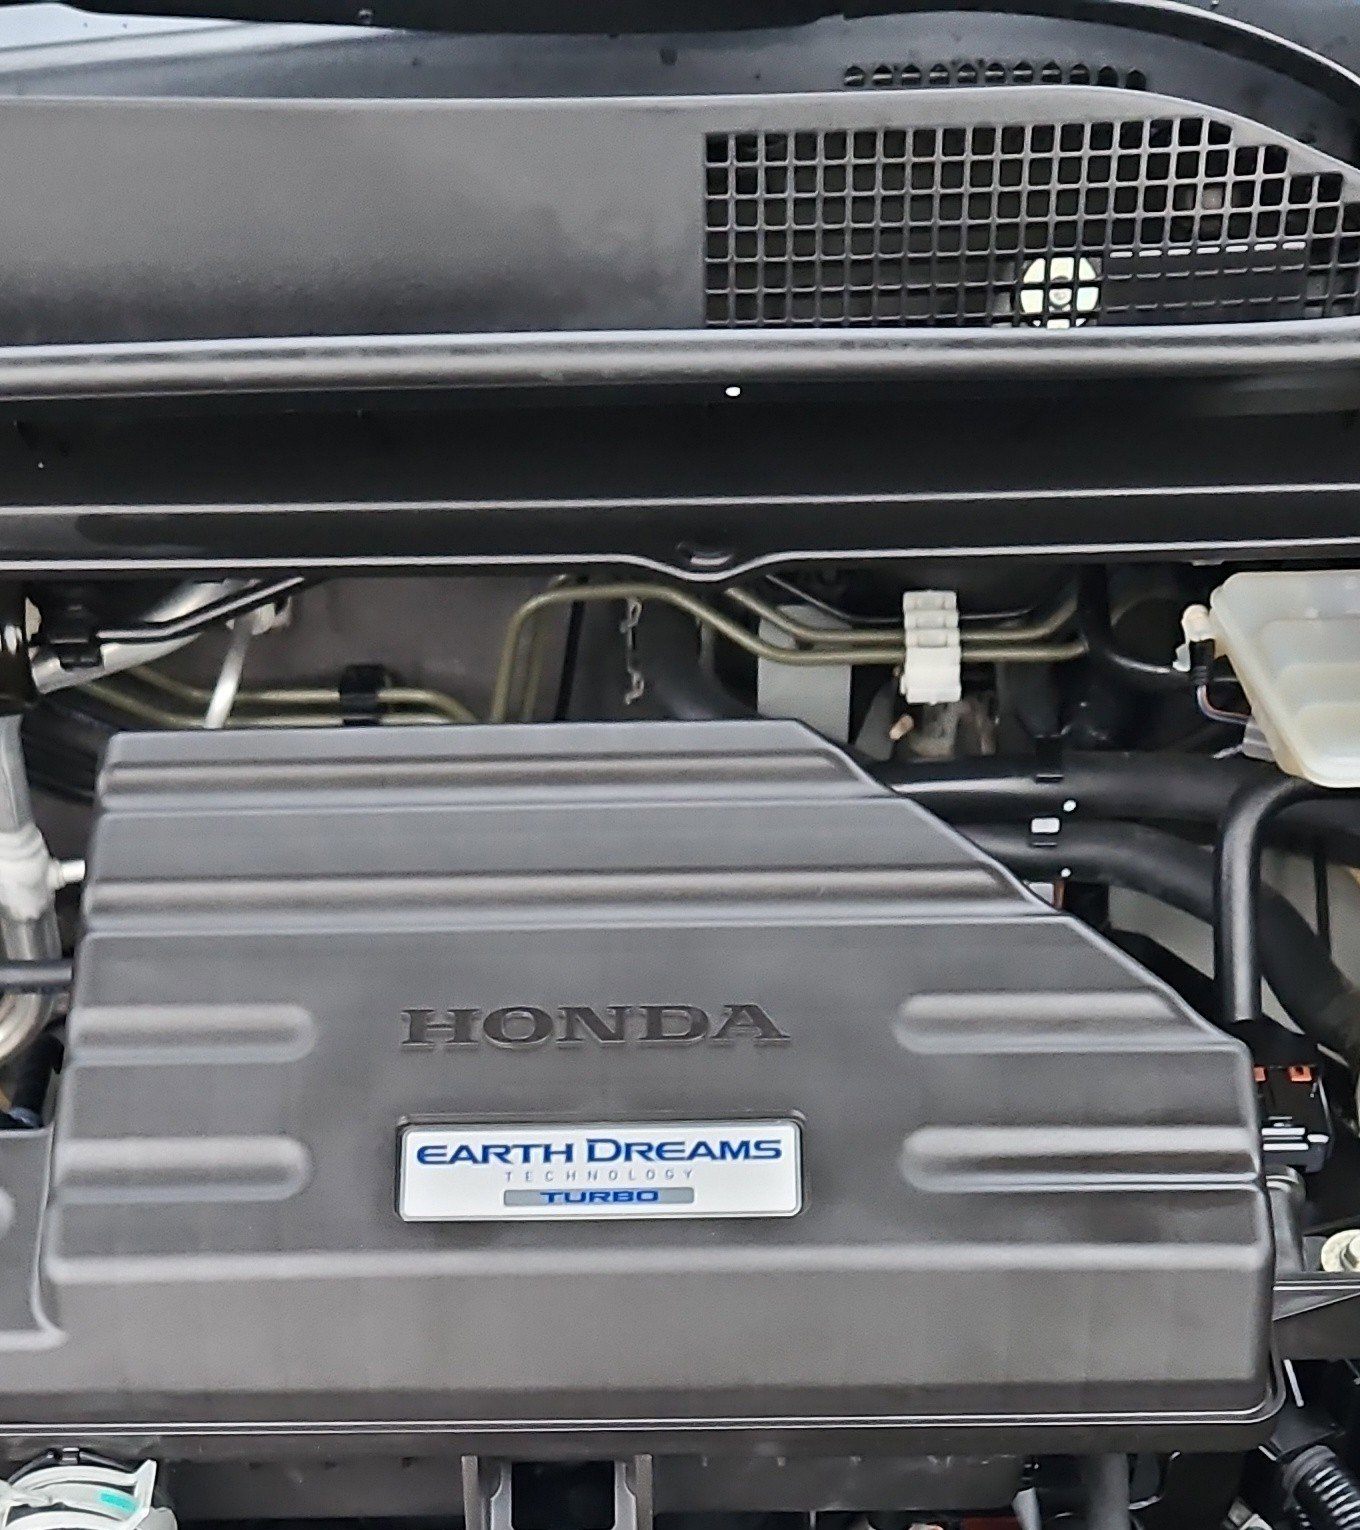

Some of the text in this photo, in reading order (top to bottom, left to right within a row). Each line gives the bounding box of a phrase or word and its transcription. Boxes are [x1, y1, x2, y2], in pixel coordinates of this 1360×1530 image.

[400, 1003, 791, 1049] HONDA
[416, 1137, 783, 1165] EARTH DREAMS
[505, 1169, 694, 1183] TECHNOLOGY
[540, 1189, 660, 1205] TURBO
